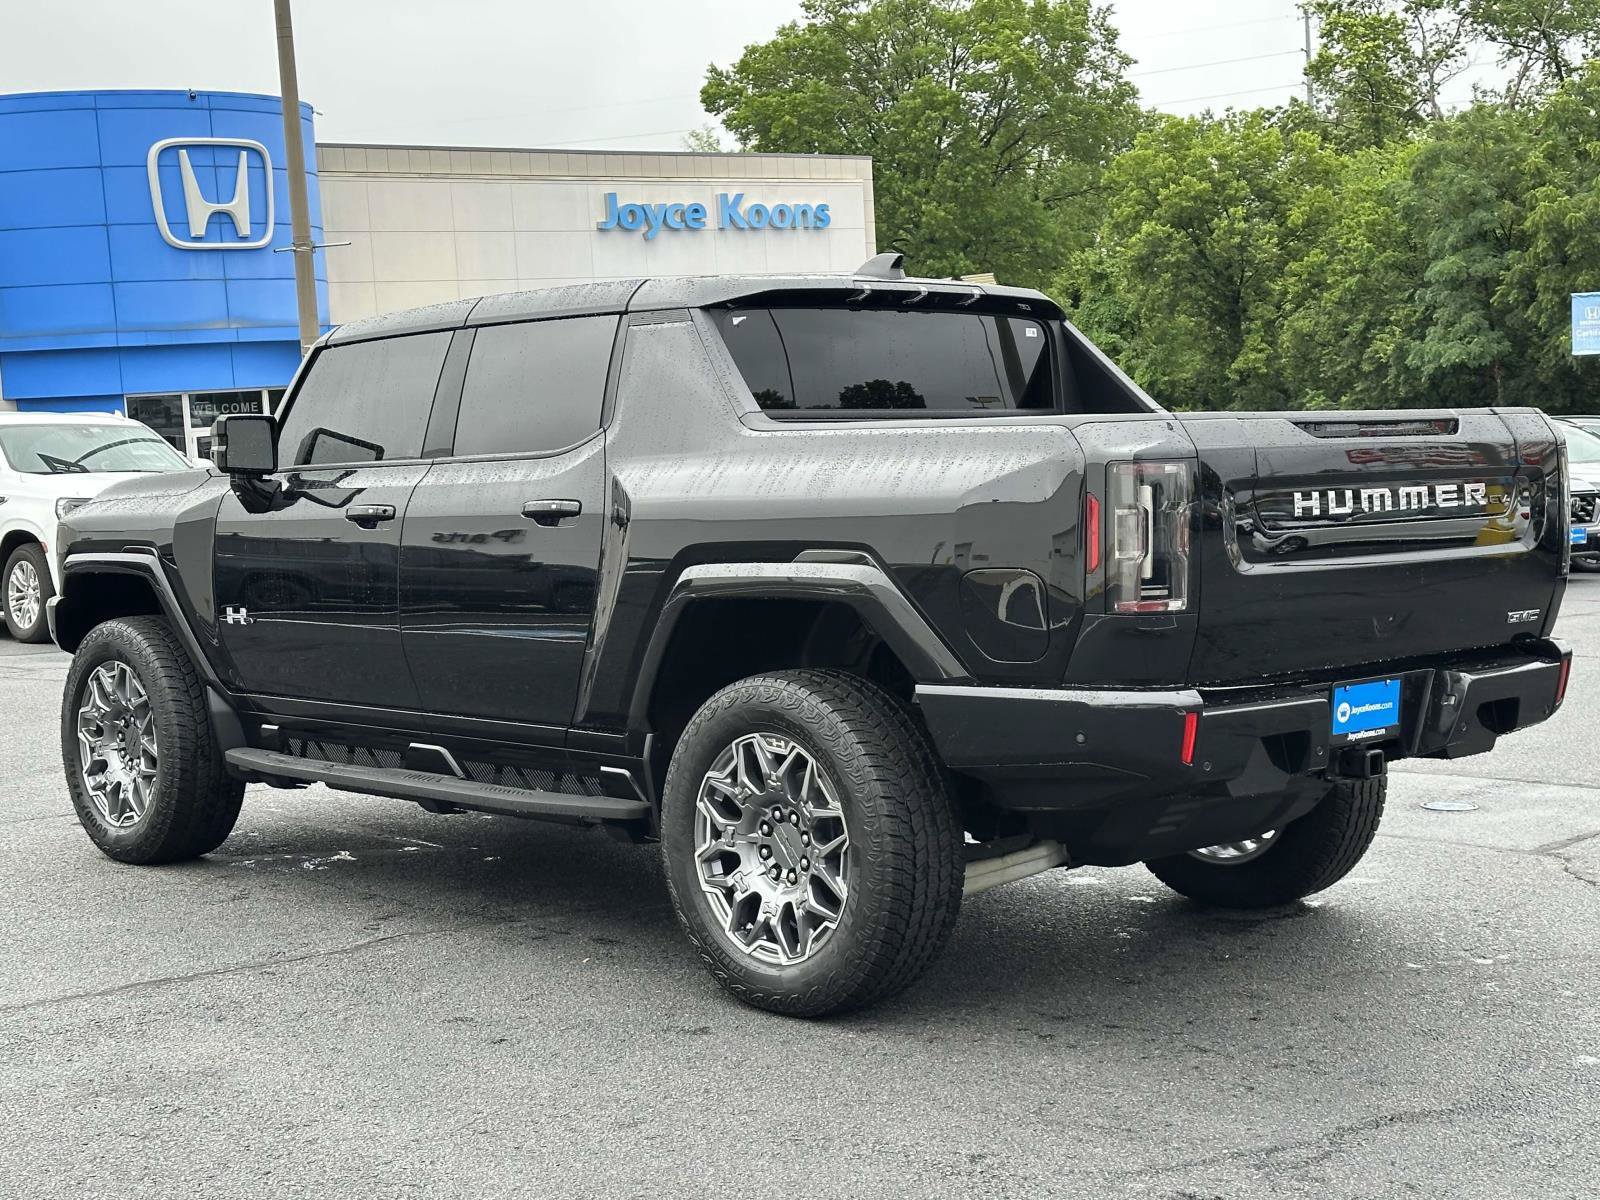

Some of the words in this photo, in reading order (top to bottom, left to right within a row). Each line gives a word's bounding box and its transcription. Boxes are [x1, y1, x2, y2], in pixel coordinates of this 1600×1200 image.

[597, 192, 707, 241] Joyce
[716, 193, 831, 230] Koons
[192, 401, 259, 414] WELCOME
[1294, 482, 1486, 517] HUMMER
[1507, 609, 1541, 623] GMC
